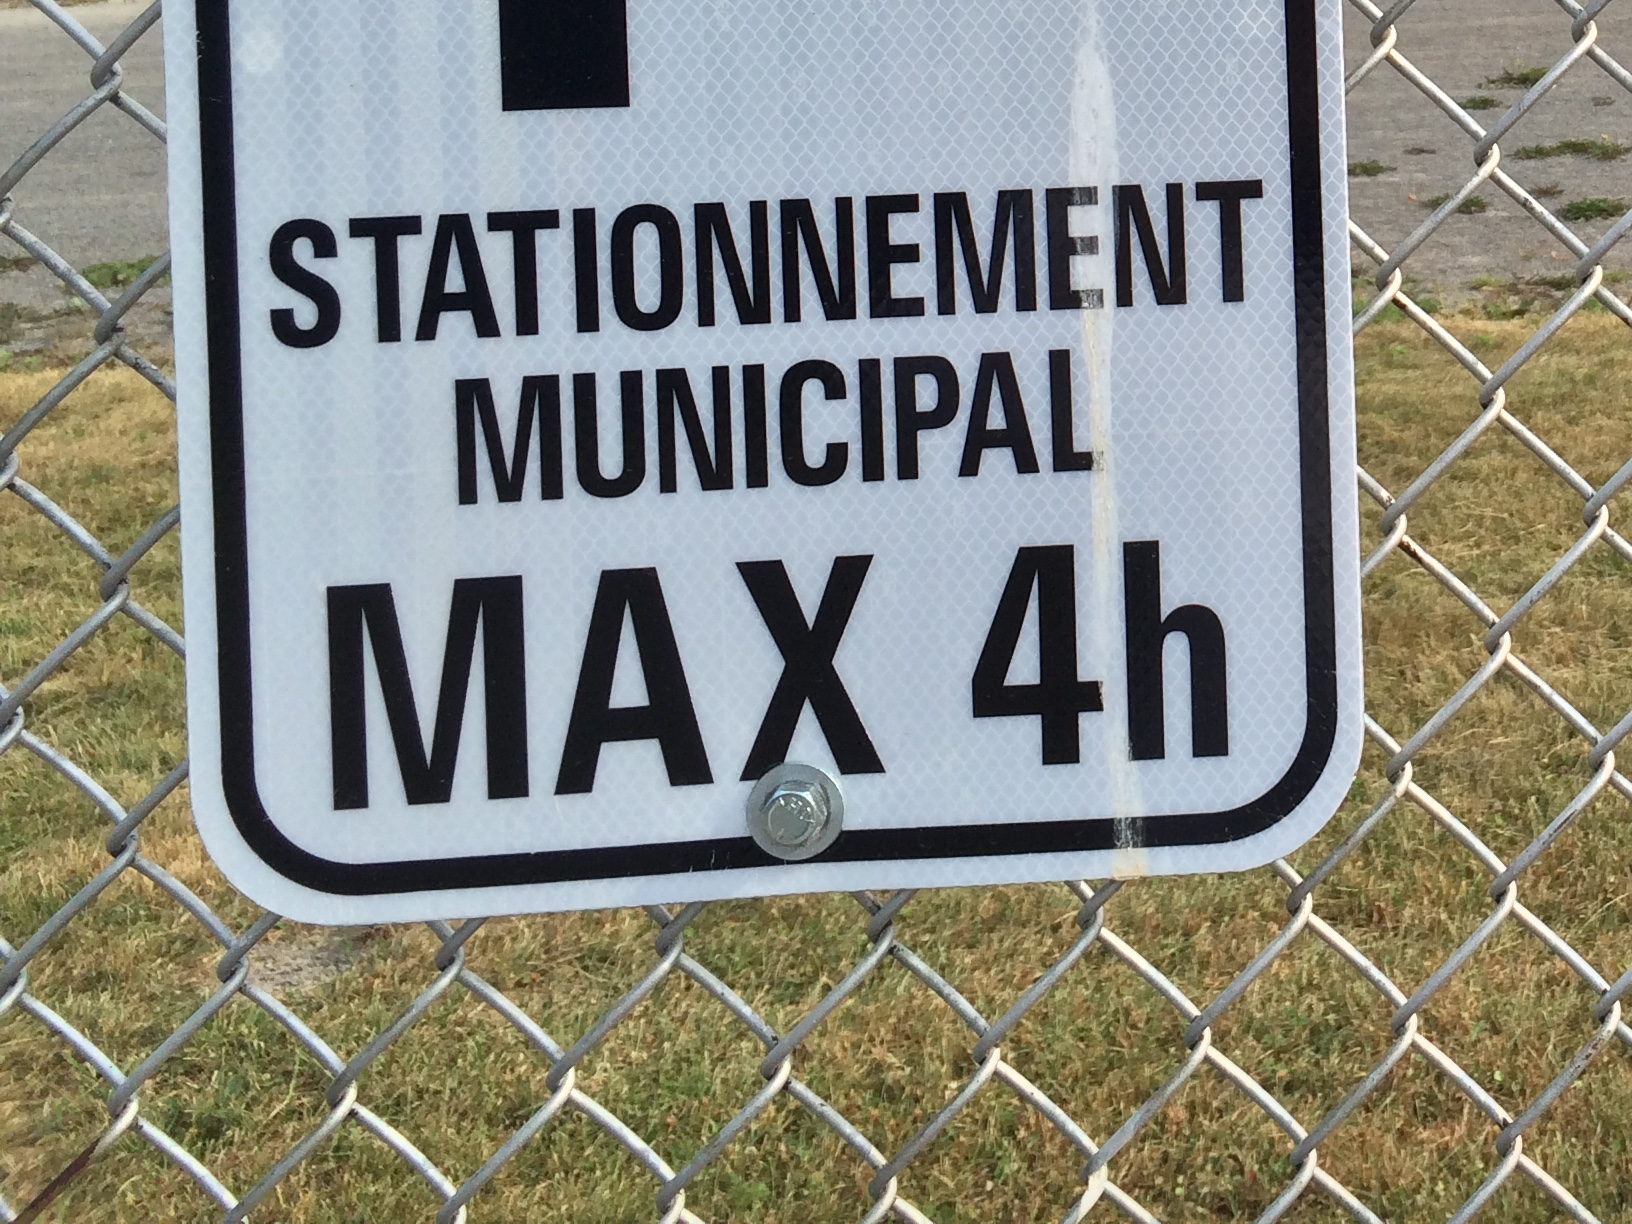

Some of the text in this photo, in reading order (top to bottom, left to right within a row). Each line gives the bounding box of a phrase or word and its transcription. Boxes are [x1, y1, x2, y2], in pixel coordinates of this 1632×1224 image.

[268, 178, 1264, 349] STATIONNEMENT
[454, 348, 1104, 506] MUNICIPAL
[325, 539, 1229, 811] MAX 4h
